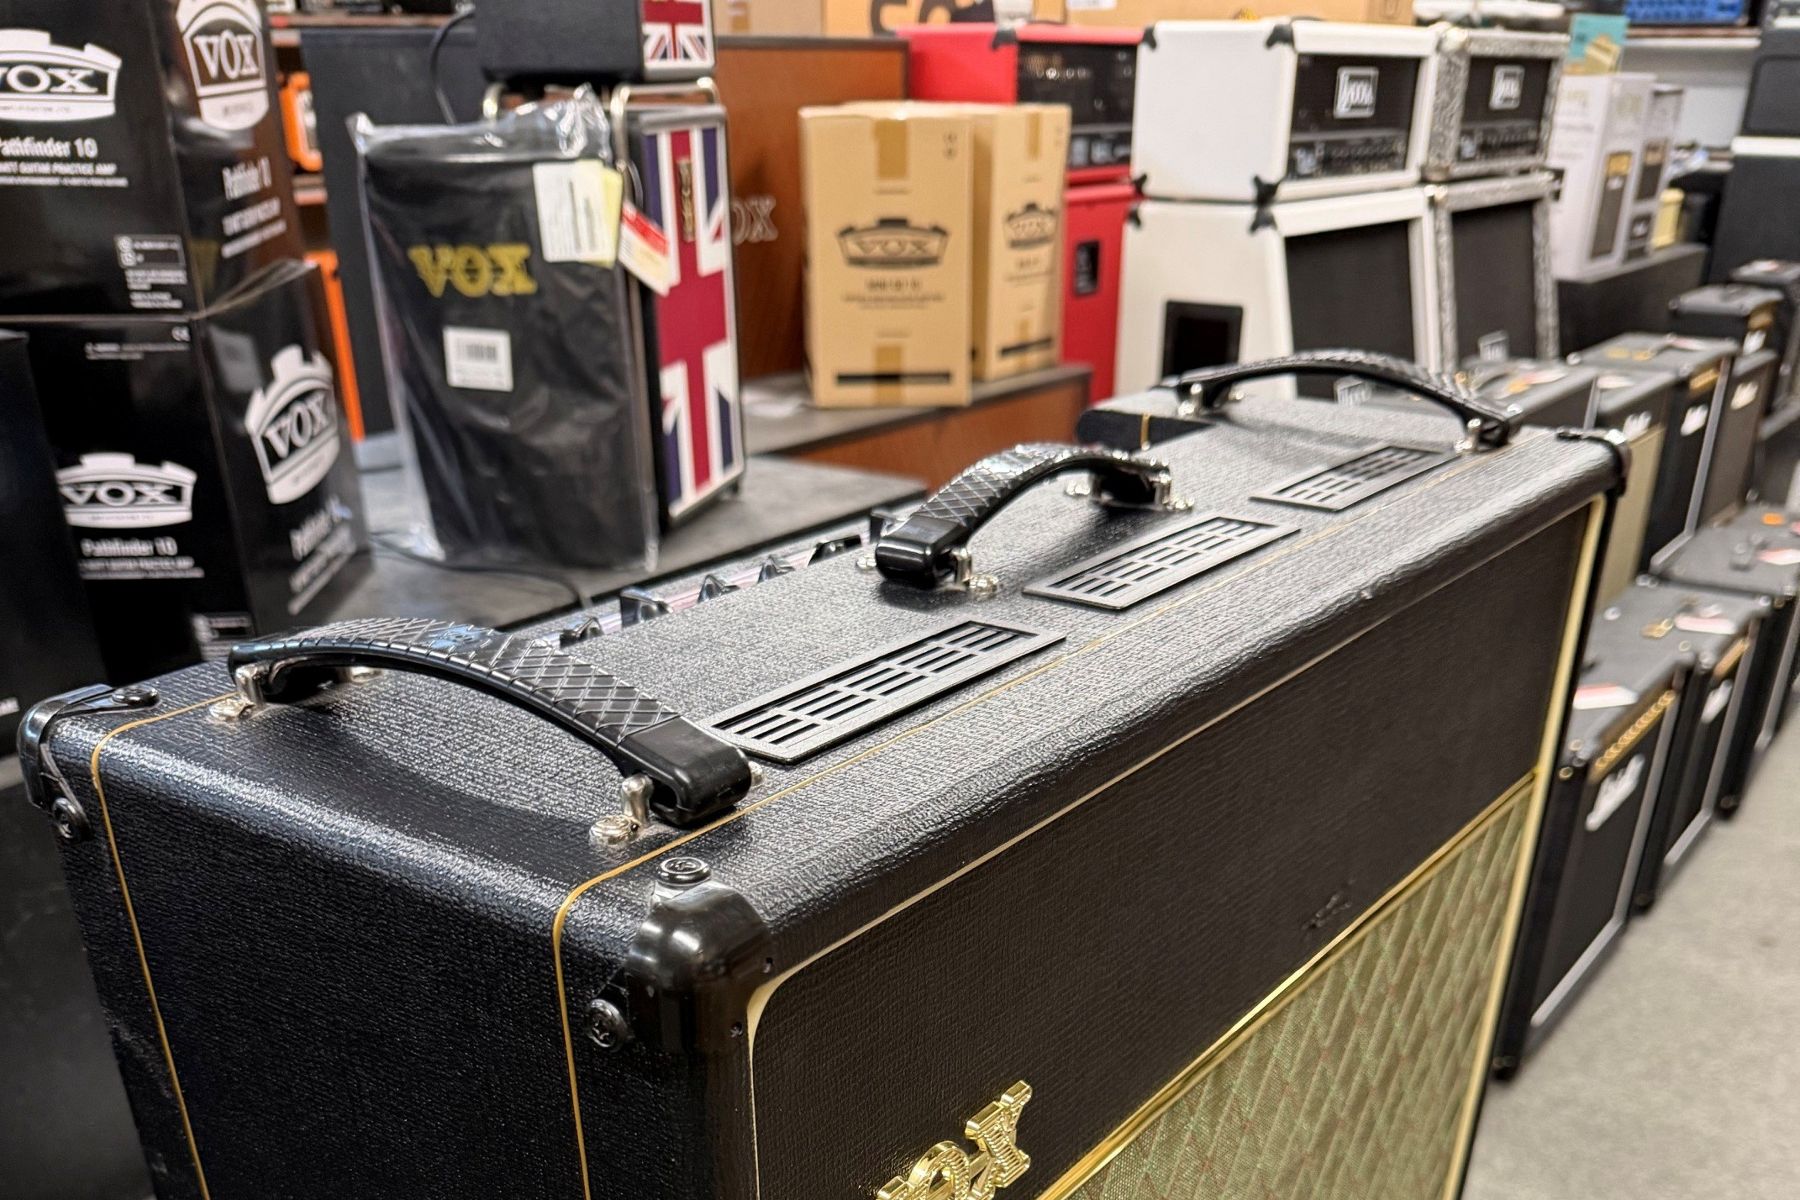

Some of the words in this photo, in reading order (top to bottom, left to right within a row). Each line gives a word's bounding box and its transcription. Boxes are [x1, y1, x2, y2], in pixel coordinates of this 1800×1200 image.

[194, 29, 259, 79] VOX
[0, 65, 98, 93] OX
[0, 136, 71, 157] athfinder
[74, 137, 98, 158] 10
[730, 196, 779, 245] OX
[855, 237, 932, 254] VOX
[408, 244, 537, 297] VOX
[265, 390, 328, 460] VOX
[60, 480, 178, 507] VOX
[154, 536, 178, 556] 10
